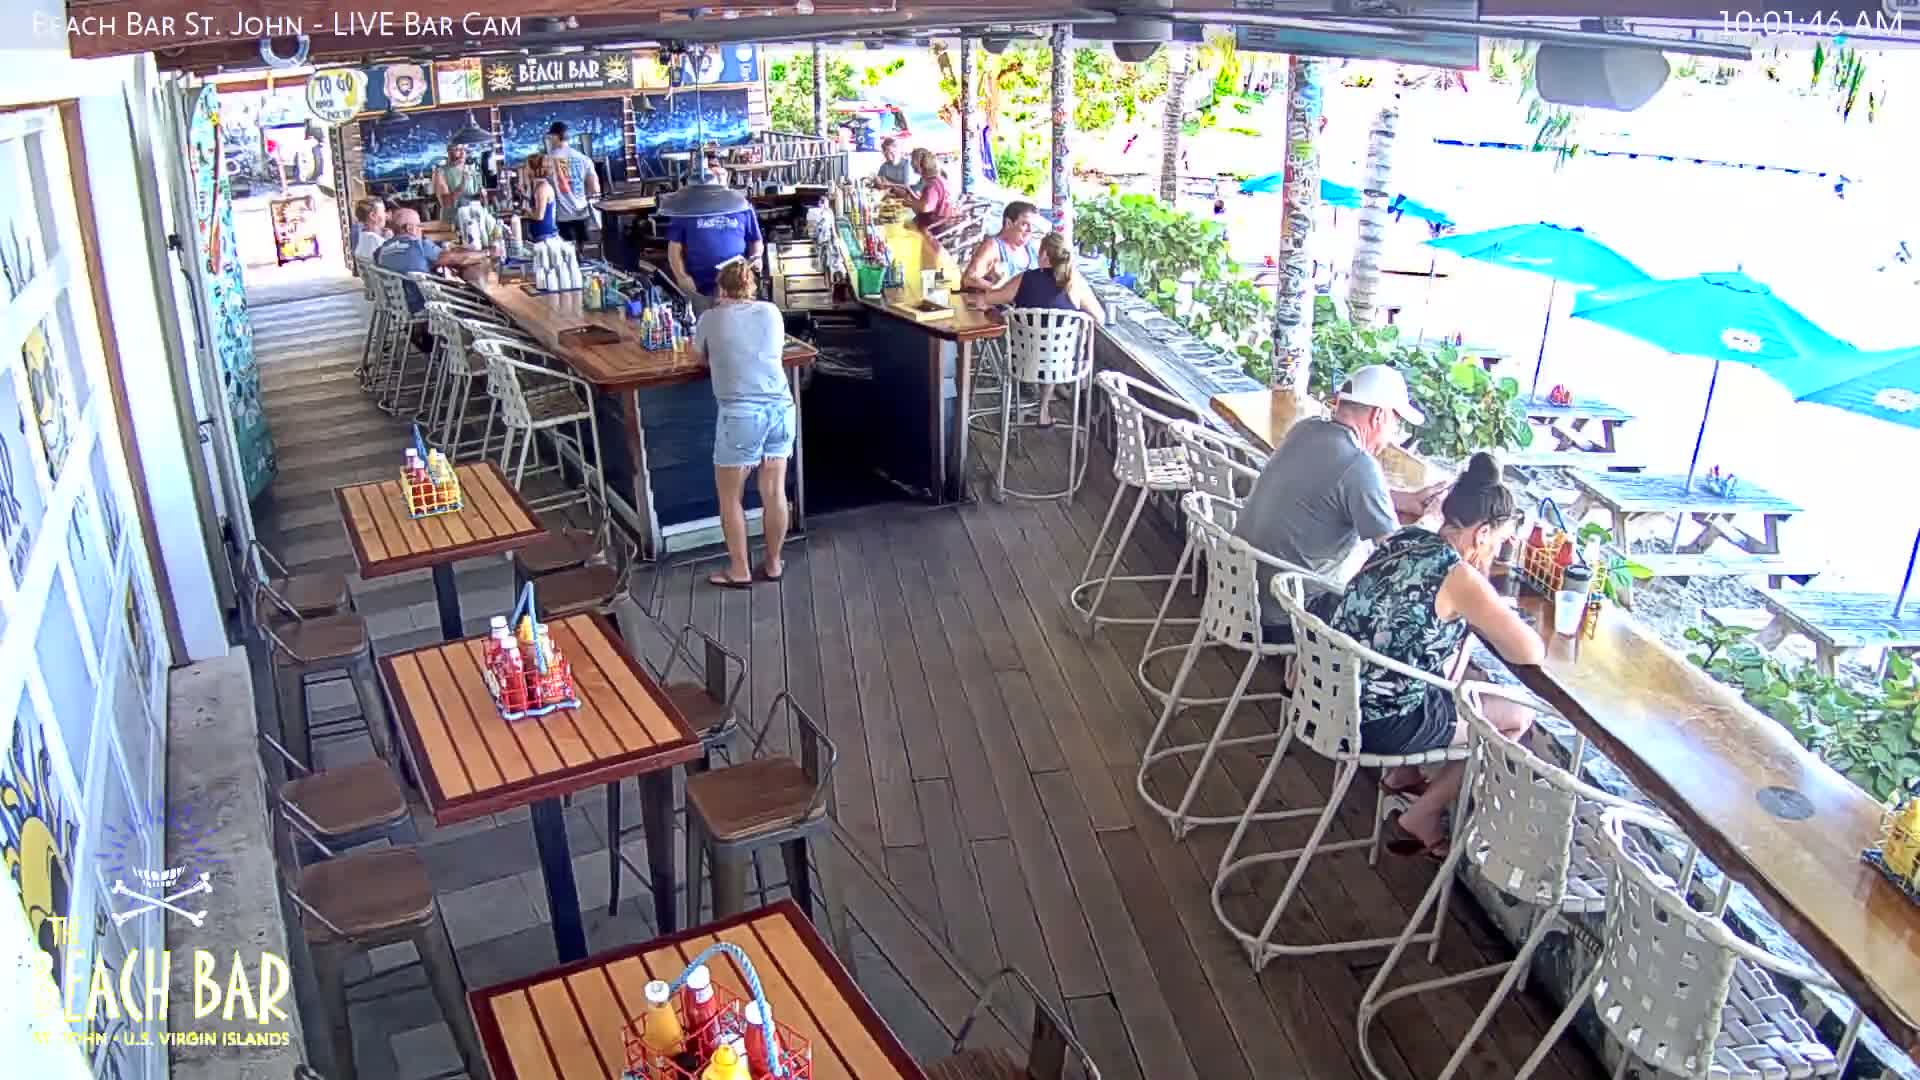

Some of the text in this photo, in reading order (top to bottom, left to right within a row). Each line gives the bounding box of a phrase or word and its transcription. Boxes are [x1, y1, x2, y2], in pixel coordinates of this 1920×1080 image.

[519, 60, 563, 82] BEACH
[568, 59, 600, 79] BAR
[314, 72, 353, 97] TO GO
